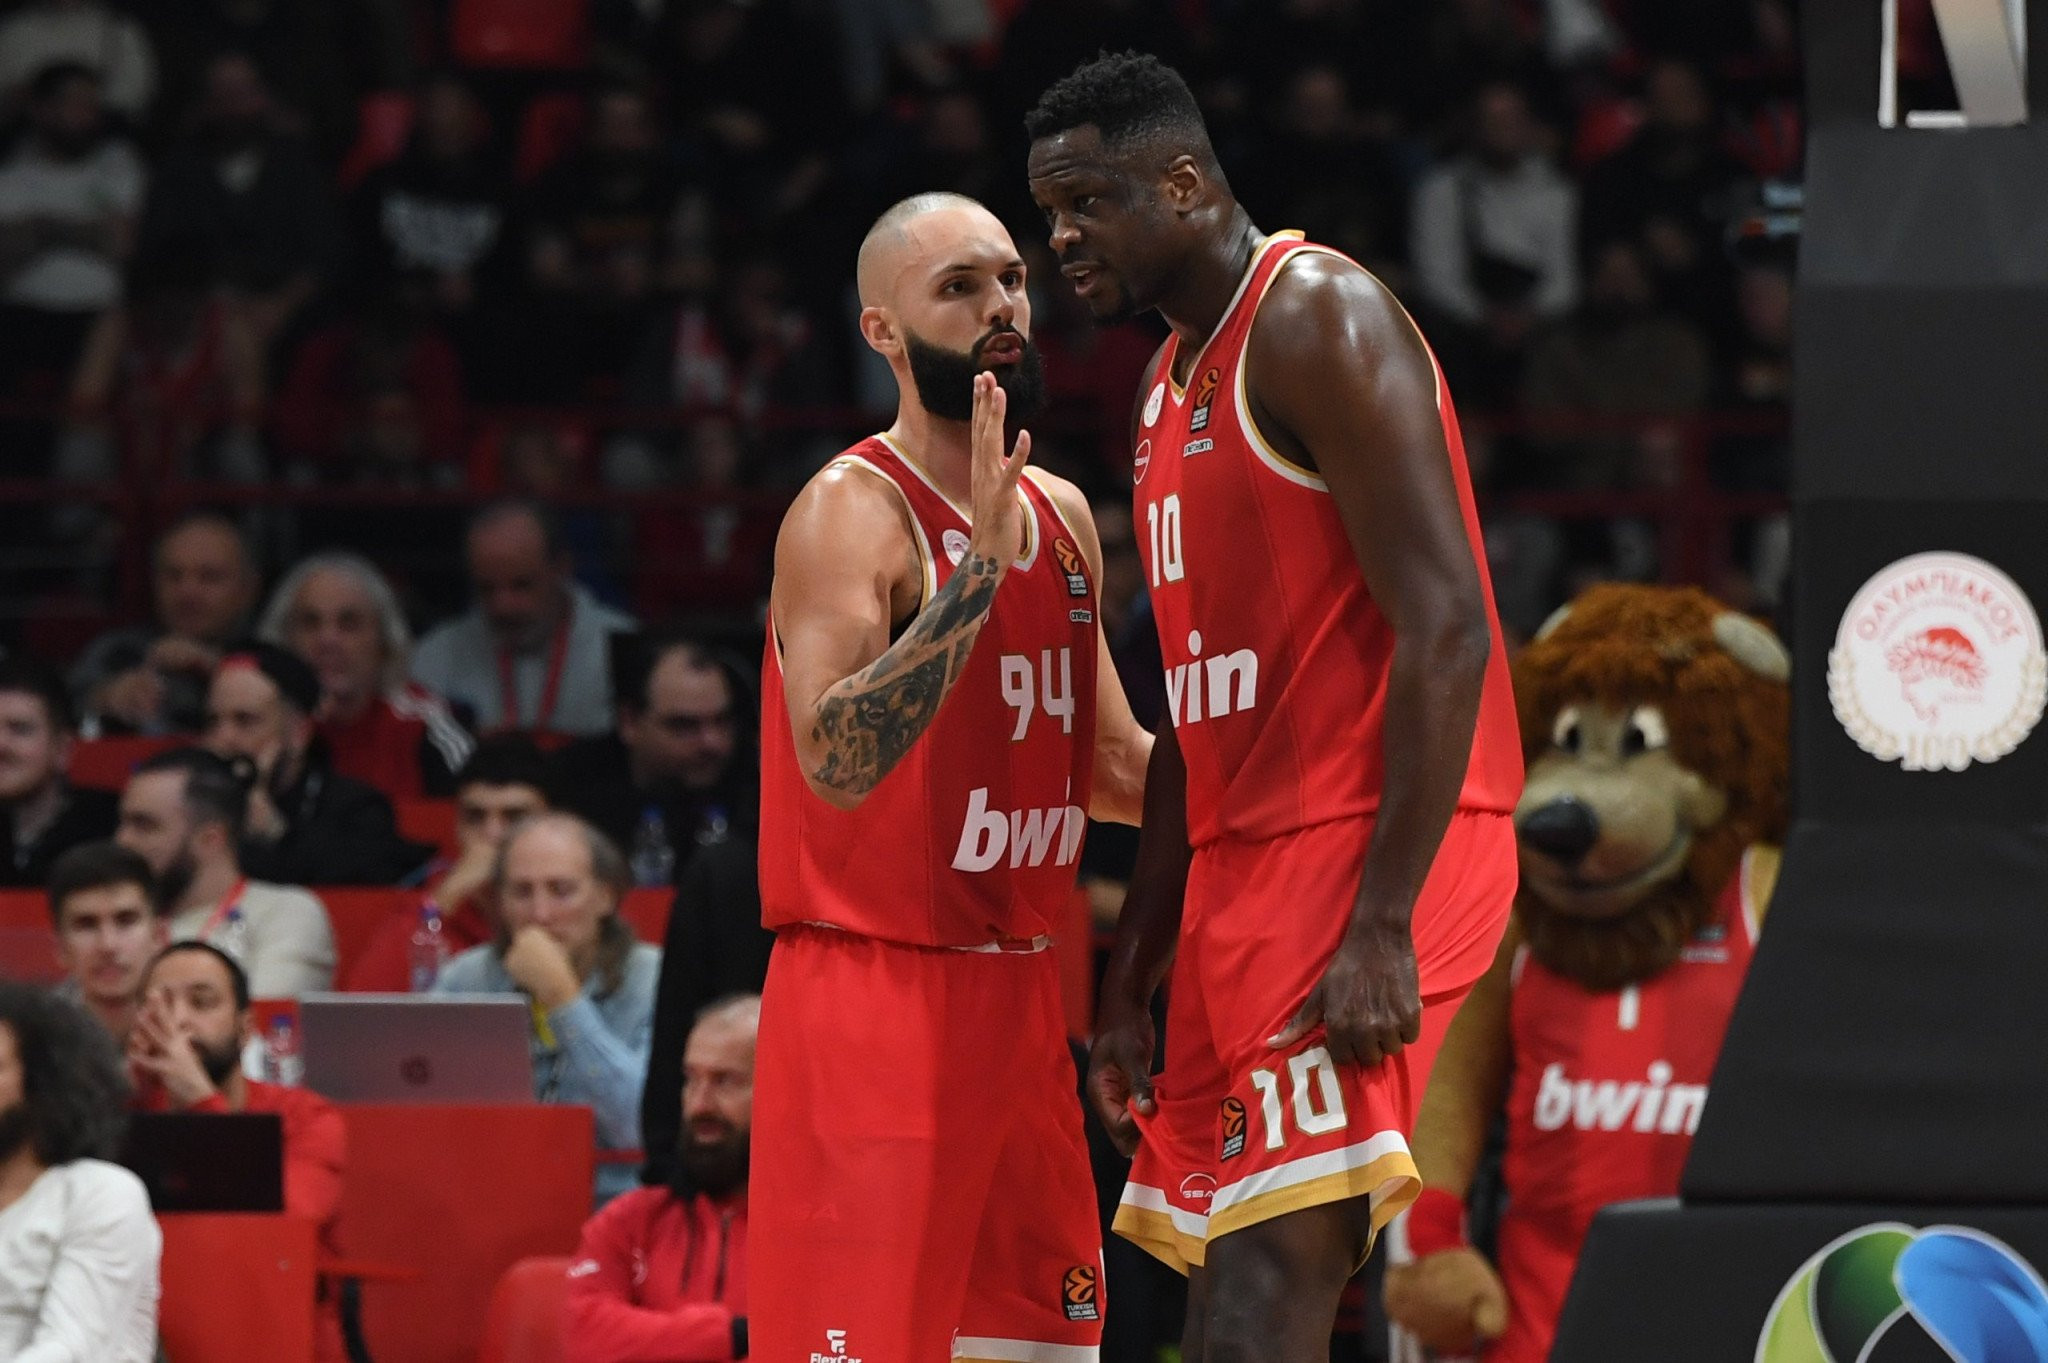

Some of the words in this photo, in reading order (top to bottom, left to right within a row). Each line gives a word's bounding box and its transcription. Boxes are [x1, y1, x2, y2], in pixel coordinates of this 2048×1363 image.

[1147, 493, 1186, 588] 10
[1000, 647, 1075, 741] 94
[1251, 1046, 1348, 1152] 10
[1532, 1060, 1710, 1137] bwin
